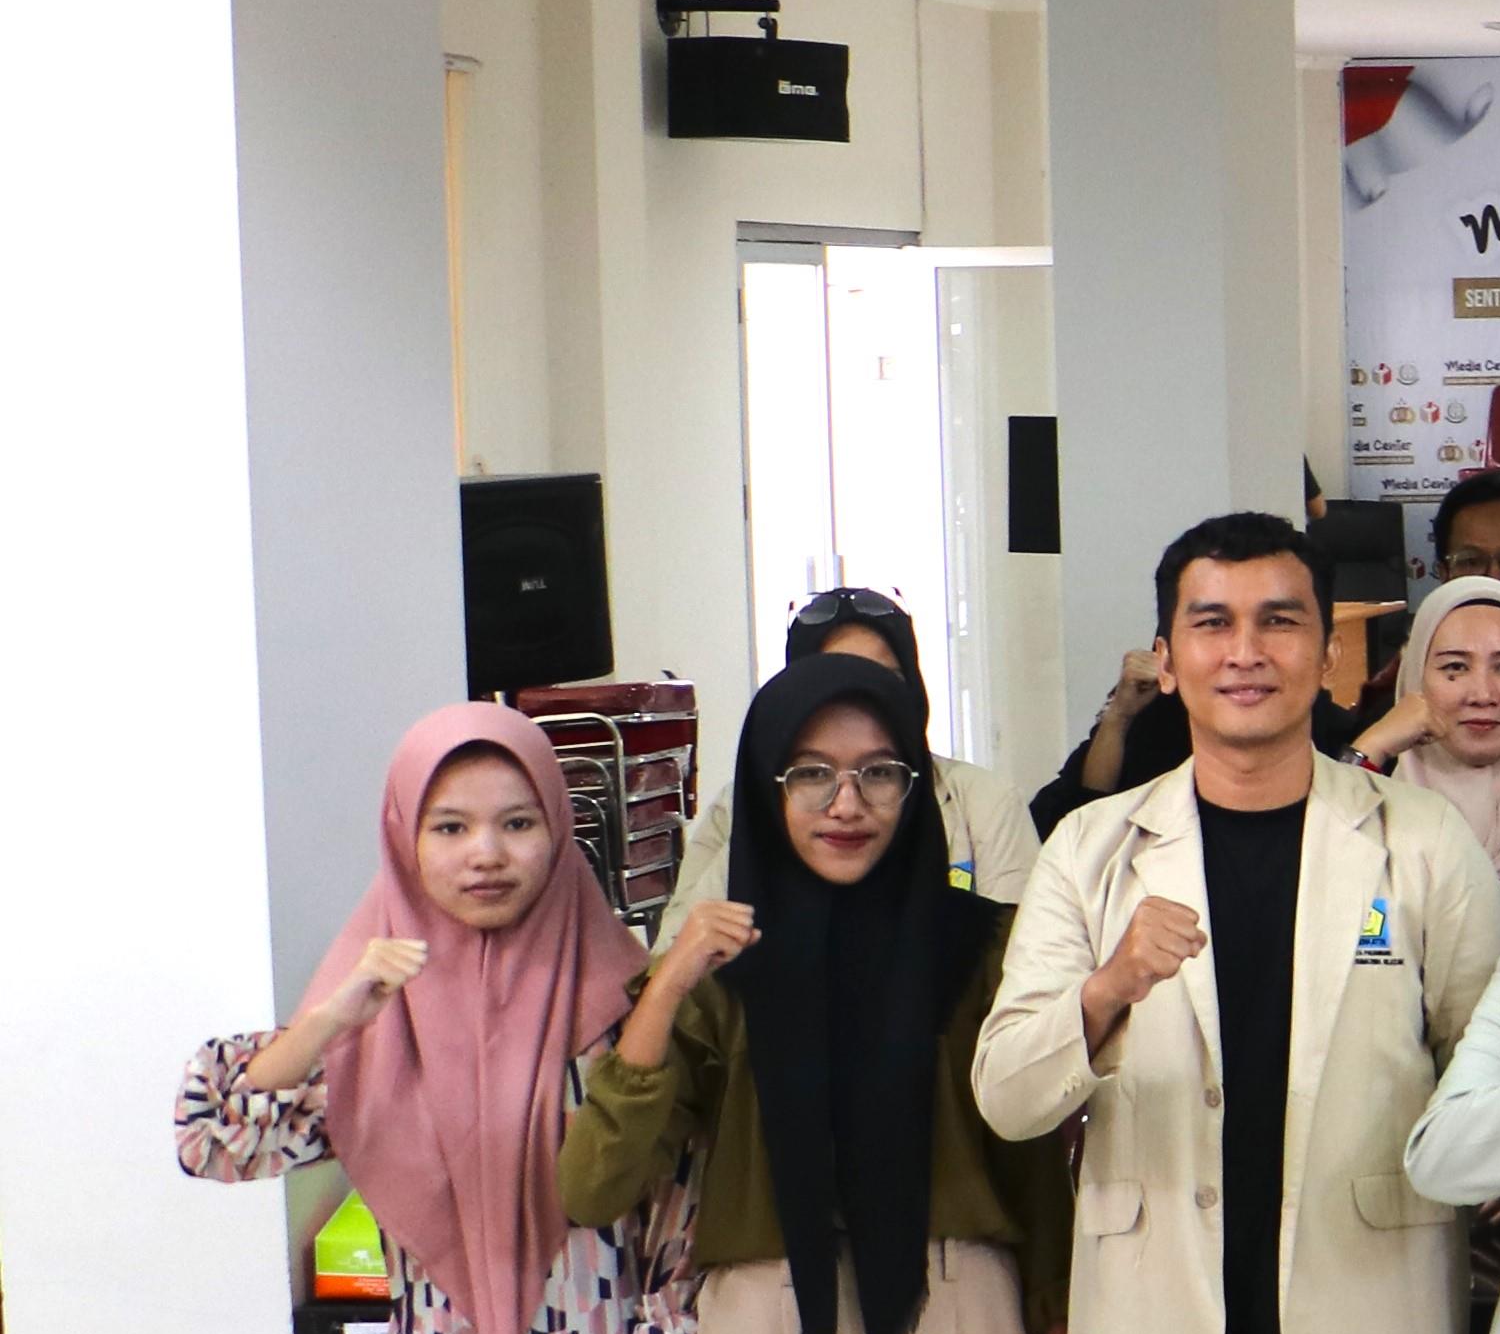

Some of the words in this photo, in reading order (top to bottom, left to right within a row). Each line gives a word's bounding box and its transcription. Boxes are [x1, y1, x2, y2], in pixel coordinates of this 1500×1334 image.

[1444, 360, 1482, 372] Media
[1373, 439, 1412, 452] Center
[1381, 479, 1418, 491] Media
